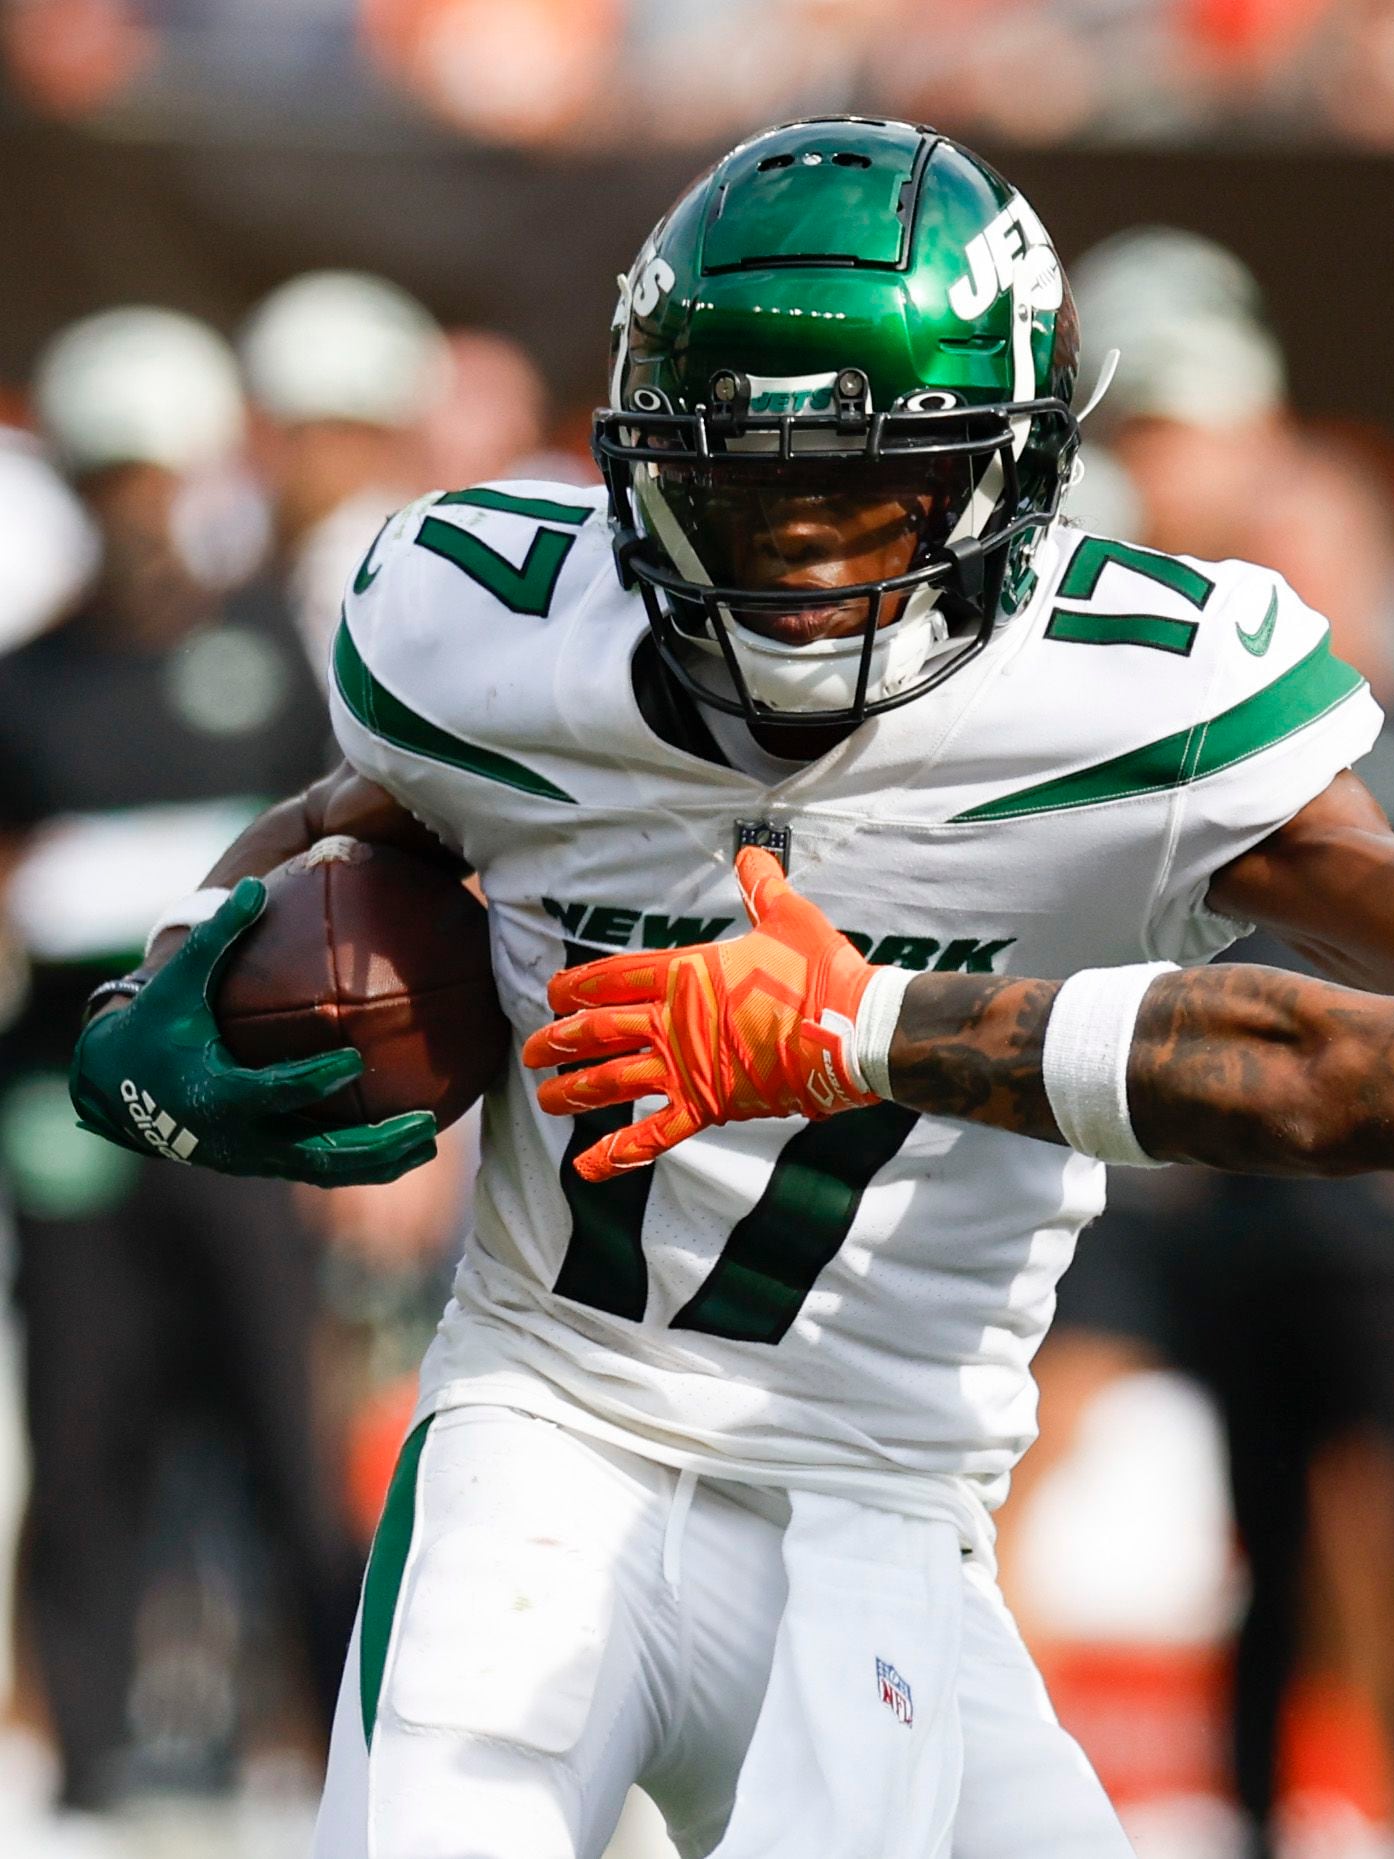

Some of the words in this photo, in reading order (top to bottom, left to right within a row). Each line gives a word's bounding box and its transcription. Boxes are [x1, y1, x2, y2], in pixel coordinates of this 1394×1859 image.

[947, 190, 1054, 320] JET
[751, 388, 834, 413] JETS
[415, 488, 595, 618] 17
[1043, 535, 1216, 657] 17
[541, 897, 736, 949] NEW
[879, 1677, 913, 1724] NFL
